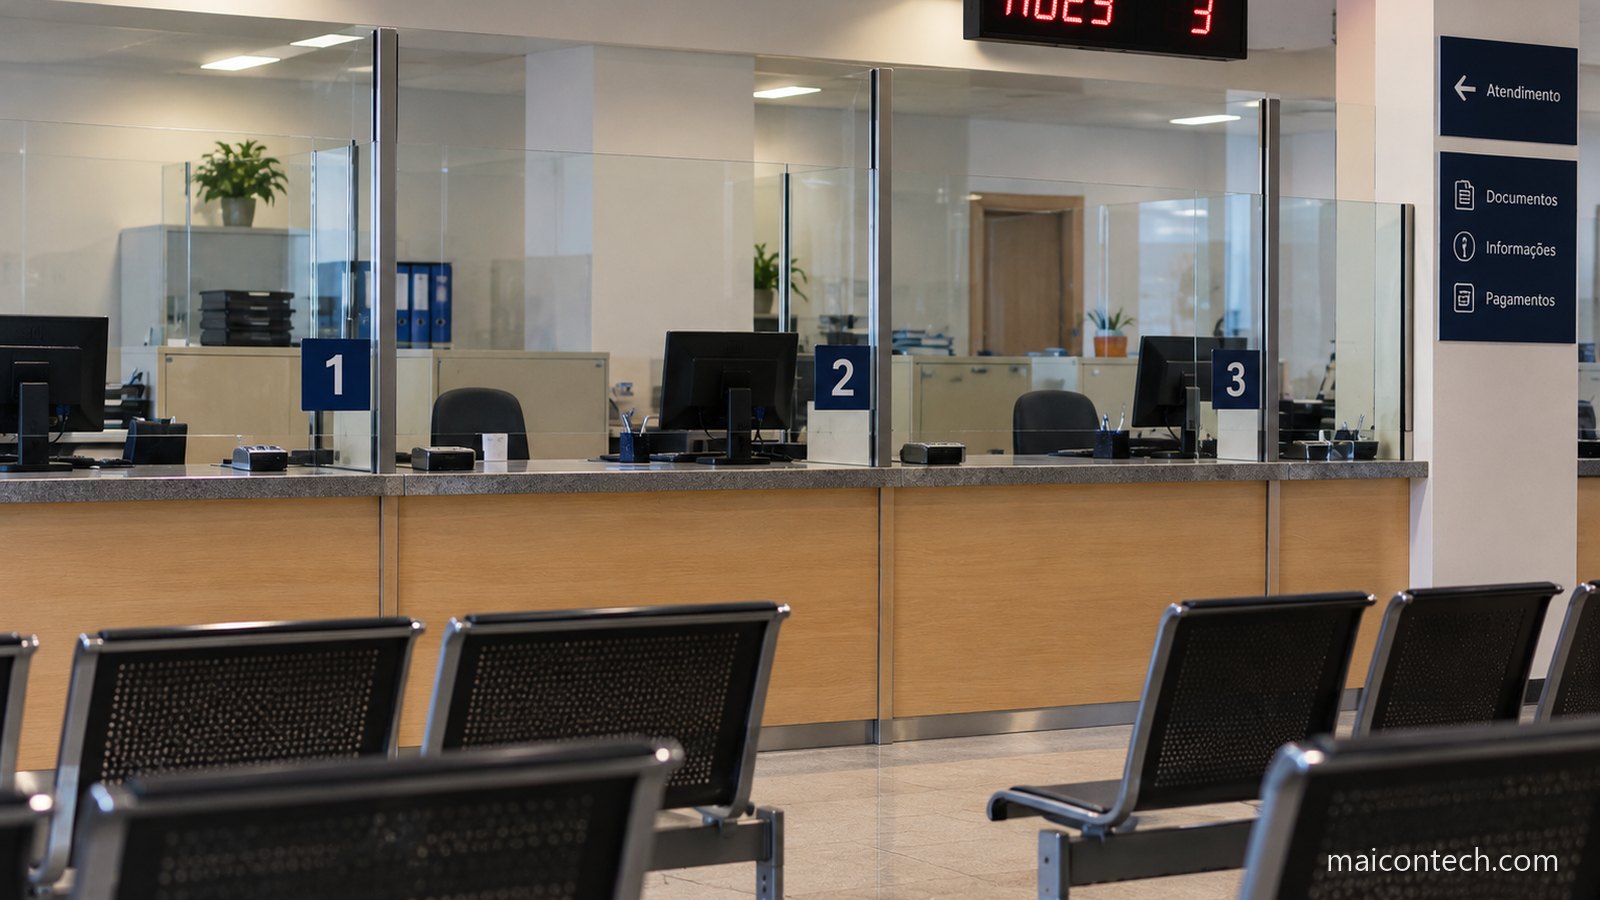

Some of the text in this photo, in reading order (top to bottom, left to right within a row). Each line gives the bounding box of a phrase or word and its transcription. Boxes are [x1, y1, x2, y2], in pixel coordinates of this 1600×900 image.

[1191, 0, 1214, 35] 3
[1486, 83, 1561, 103] Atendimento
[1486, 189, 1558, 207] Documentos
[1486, 240, 1557, 260] Informações
[1486, 291, 1556, 309] Pagamentos
[325, 354, 343, 395] 1
[831, 358, 854, 396] 2
[1226, 361, 1246, 397] 3
